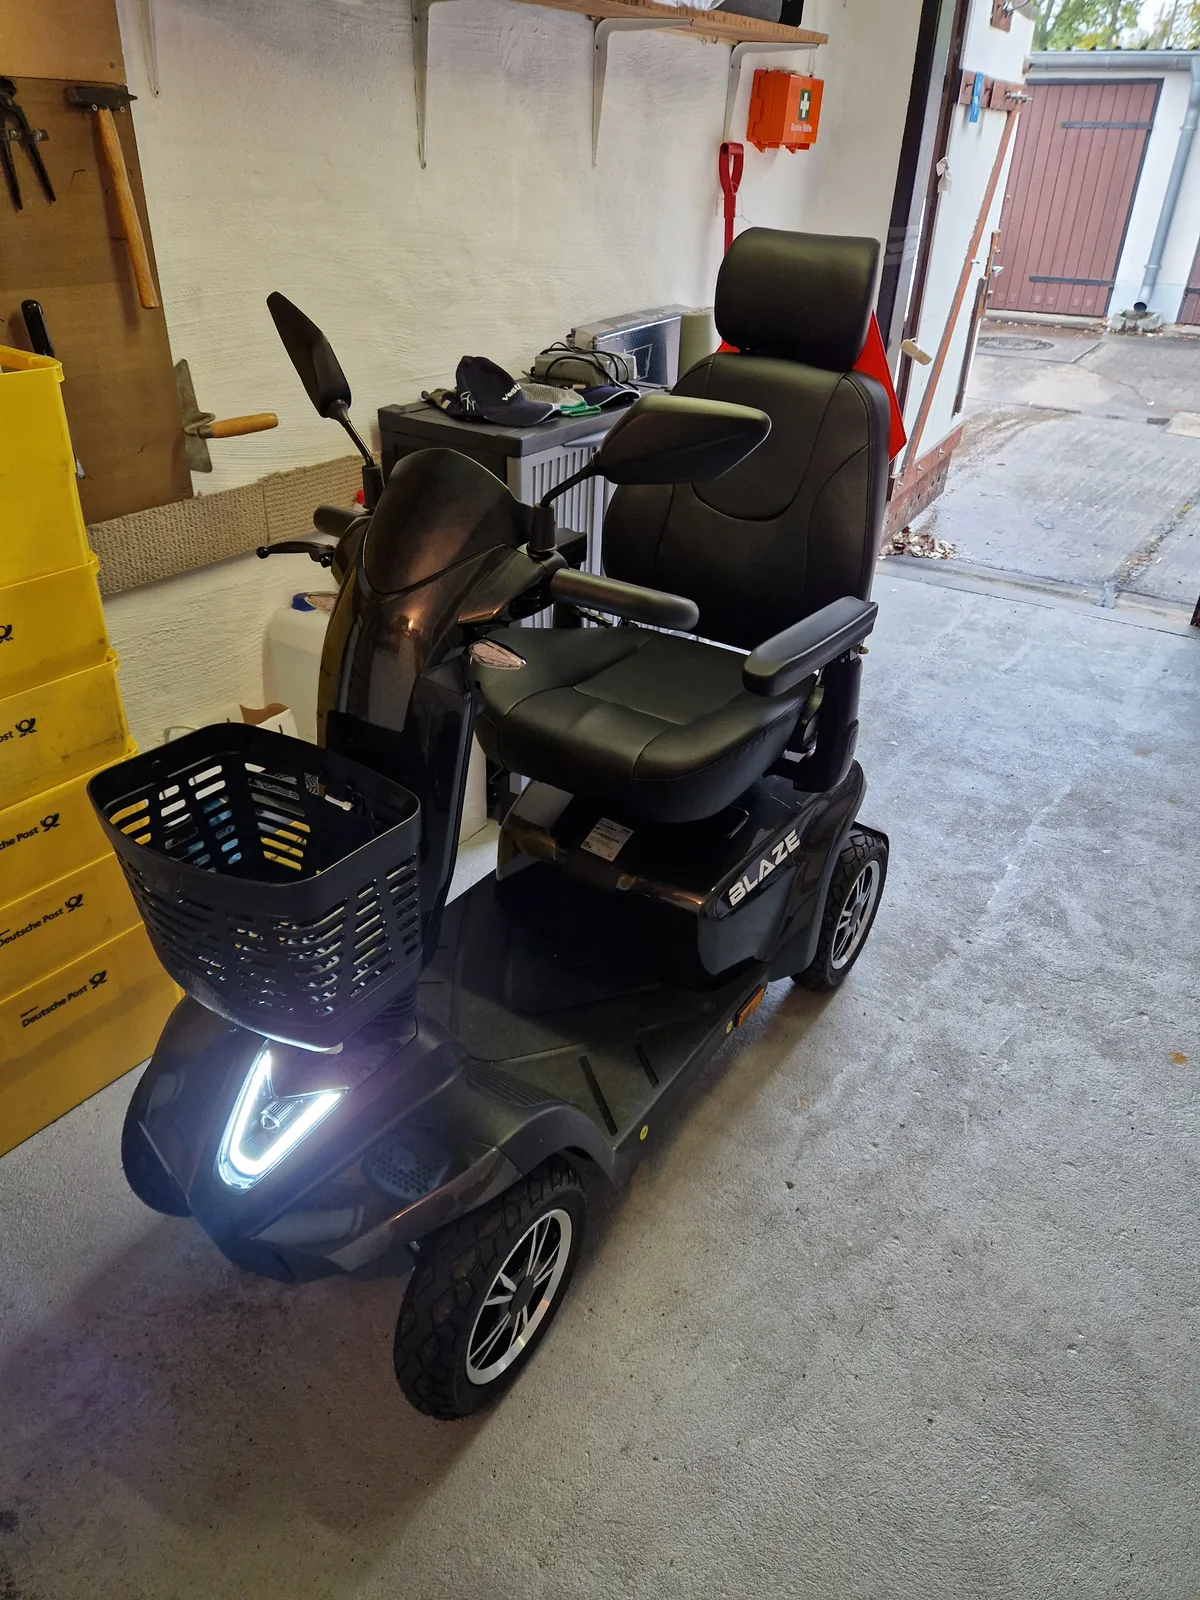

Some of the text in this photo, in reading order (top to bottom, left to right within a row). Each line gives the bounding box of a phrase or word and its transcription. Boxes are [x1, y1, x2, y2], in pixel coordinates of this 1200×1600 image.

[16, 826, 39, 842] Post
[728, 828, 801, 907] BLAZE
[42, 908, 65, 924] Post
[22, 998, 67, 1028] Deutsche
[67, 984, 89, 1001] Post
